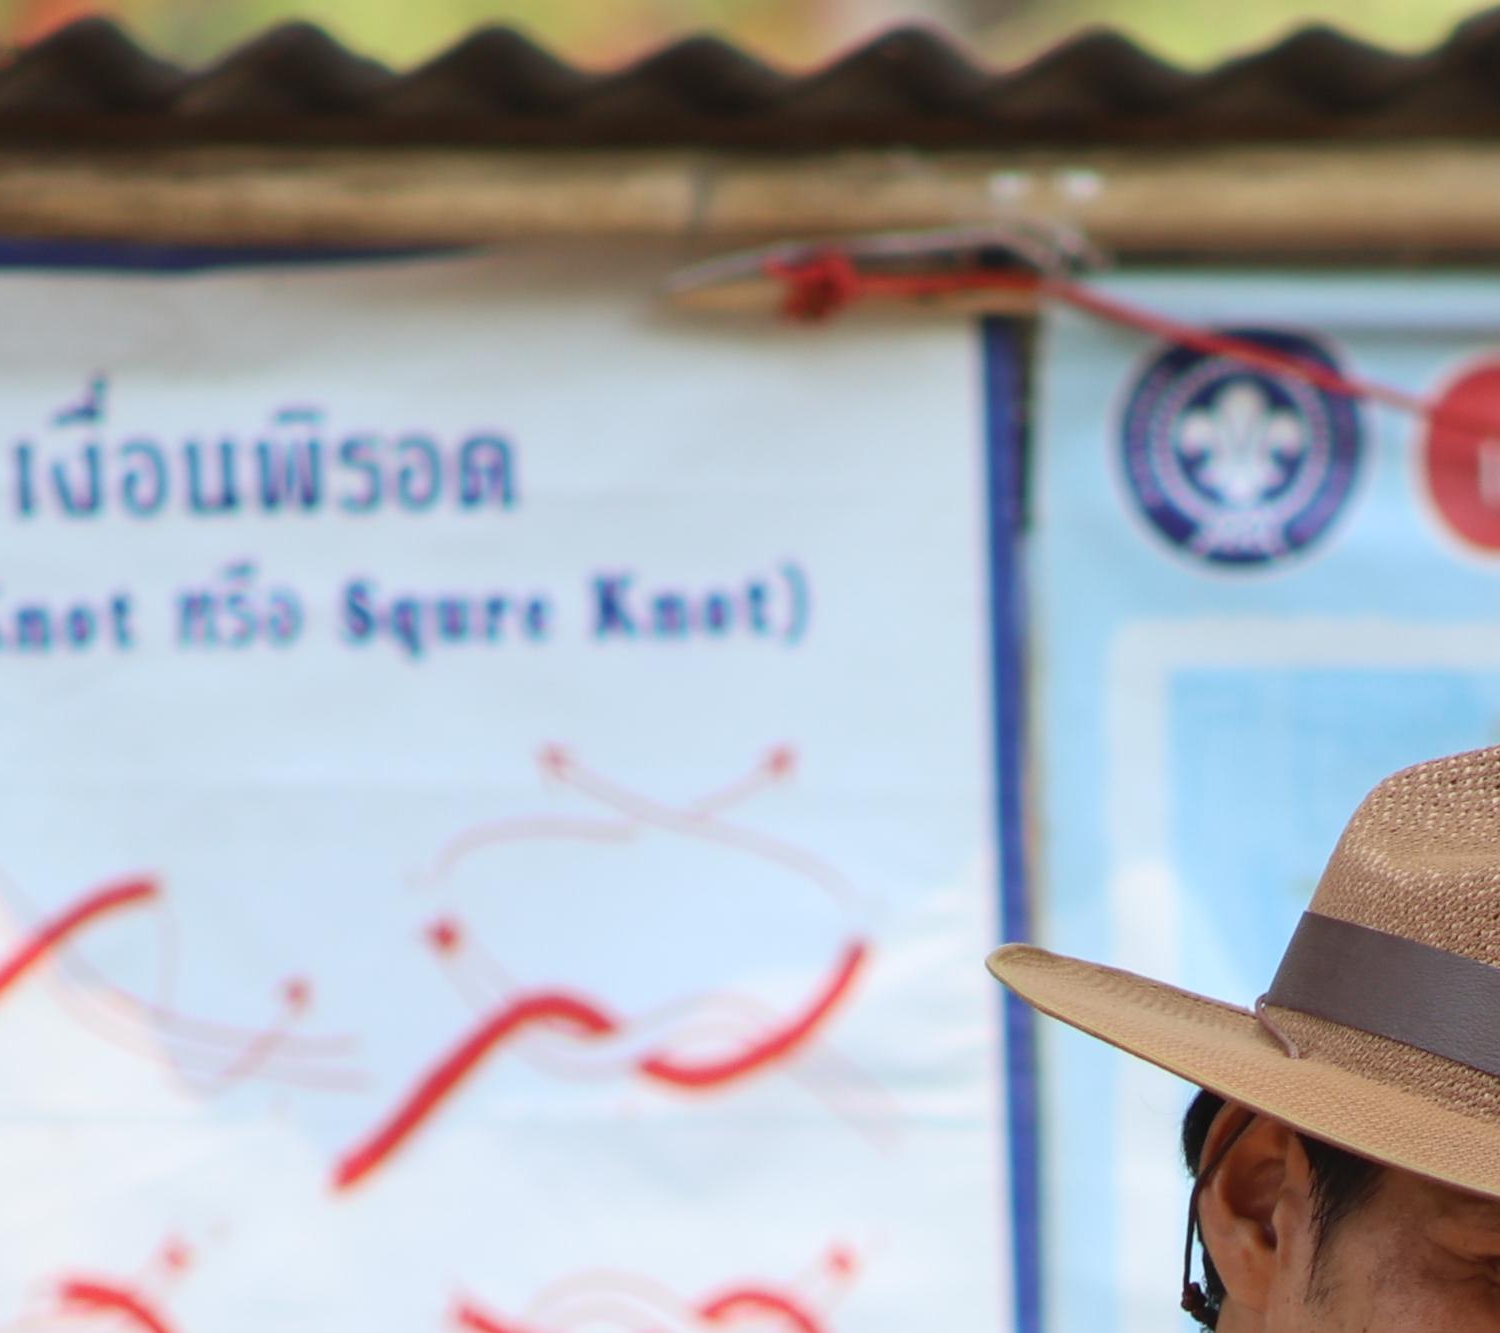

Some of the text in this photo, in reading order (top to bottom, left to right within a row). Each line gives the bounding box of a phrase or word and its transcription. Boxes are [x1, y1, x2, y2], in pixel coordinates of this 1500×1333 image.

[12, 372, 518, 520] เงื่อนพิรอด
[592, 562, 809, 648] Knot)
